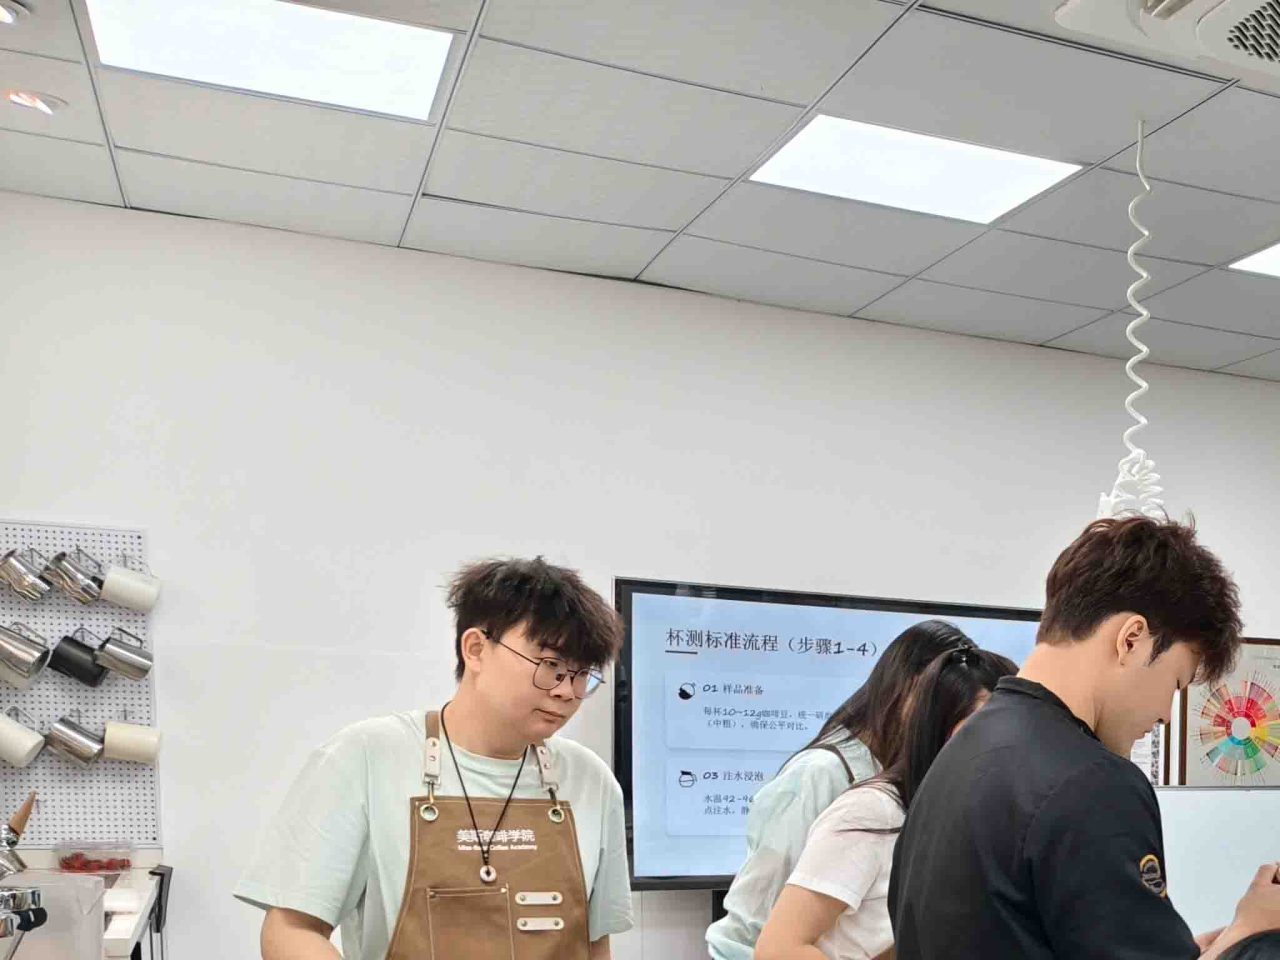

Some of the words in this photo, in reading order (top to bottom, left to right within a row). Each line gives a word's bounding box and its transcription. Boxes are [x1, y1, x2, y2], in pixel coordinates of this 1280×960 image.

[666, 628, 878, 657] 杯测标准流程（步骤1-4）
[702, 684, 719, 693] 01
[723, 683, 764, 696] 样品准备
[702, 771, 719, 781] 03
[722, 770, 764, 782] 注水浸泡
